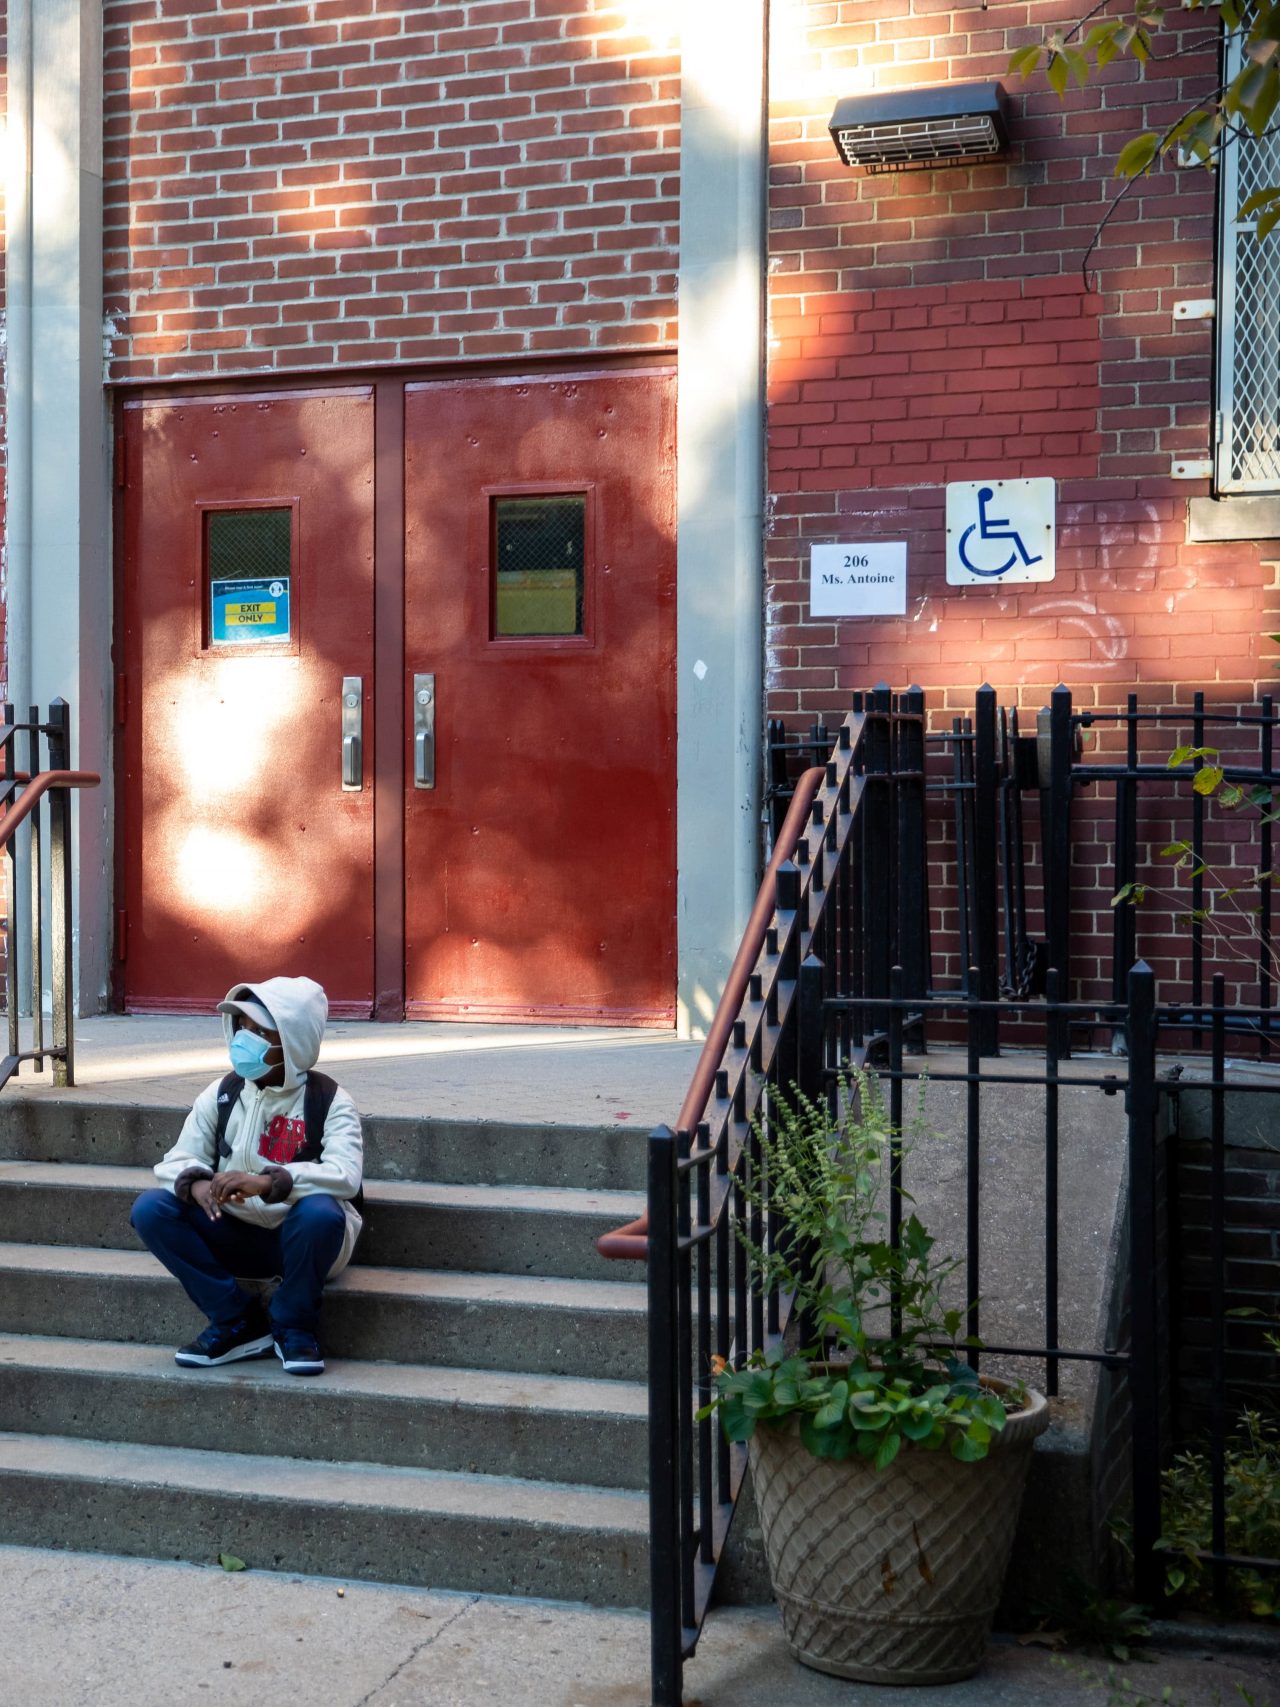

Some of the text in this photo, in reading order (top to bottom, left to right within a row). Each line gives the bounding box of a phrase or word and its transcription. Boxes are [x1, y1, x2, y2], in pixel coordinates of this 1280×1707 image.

[843, 554, 869, 568] 206
[822, 573, 895, 584] Ms. Antoine
[240, 604, 261, 613] EXIT
[238, 614, 263, 623] ONLY
